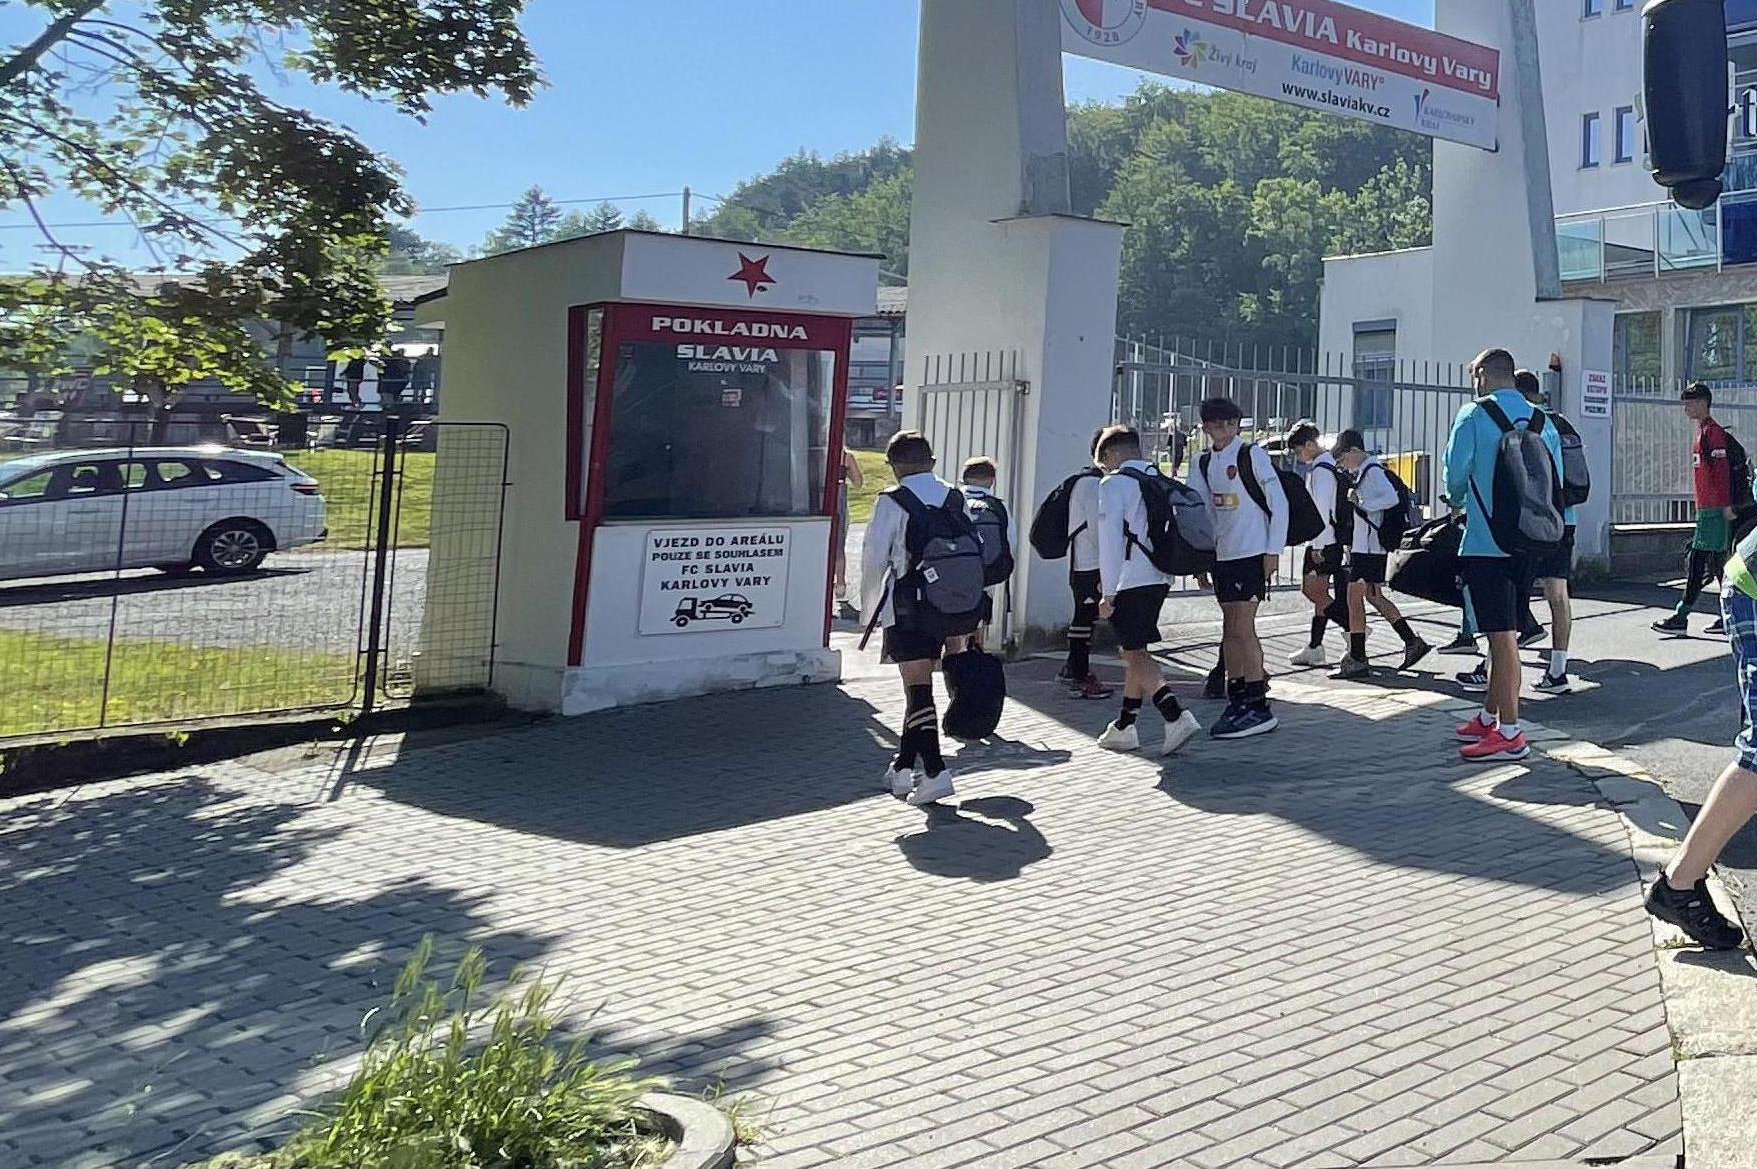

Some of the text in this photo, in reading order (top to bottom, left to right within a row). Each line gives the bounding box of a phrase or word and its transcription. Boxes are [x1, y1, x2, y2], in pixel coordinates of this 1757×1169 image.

[1346, 29, 1438, 75] Karlovy
[1442, 55, 1491, 91] Vary
[1281, 82, 1391, 118] www.slaviakv.cz
[652, 316, 809, 340] POKLADNA
[676, 344, 778, 362] SLAVIA
[688, 361, 766, 373] KARLOVY VARY
[654, 532, 785, 548] VJEZD DO AREÁLU
[652, 548, 784, 561] POUZE SE SOUHLASEM
[681, 563, 754, 575] FC SLAVIA
[660, 576, 771, 591] KARLOVY VARY
